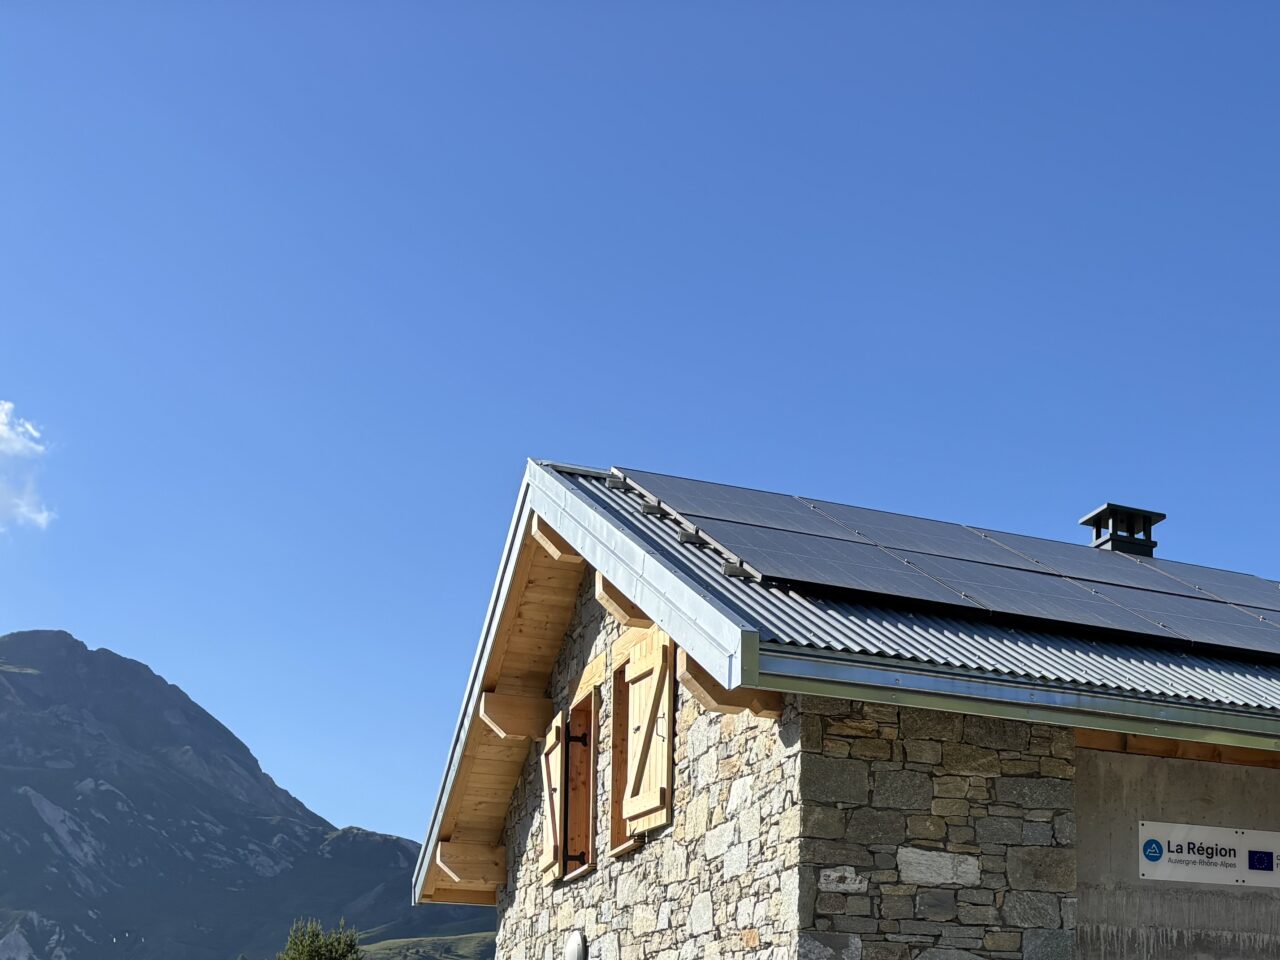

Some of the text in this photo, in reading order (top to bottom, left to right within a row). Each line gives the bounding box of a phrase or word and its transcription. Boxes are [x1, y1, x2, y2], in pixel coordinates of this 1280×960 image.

[1167, 840, 1237, 860] La Région
[1167, 857, 1237, 869] Auvergne-Rhône-Alpes
